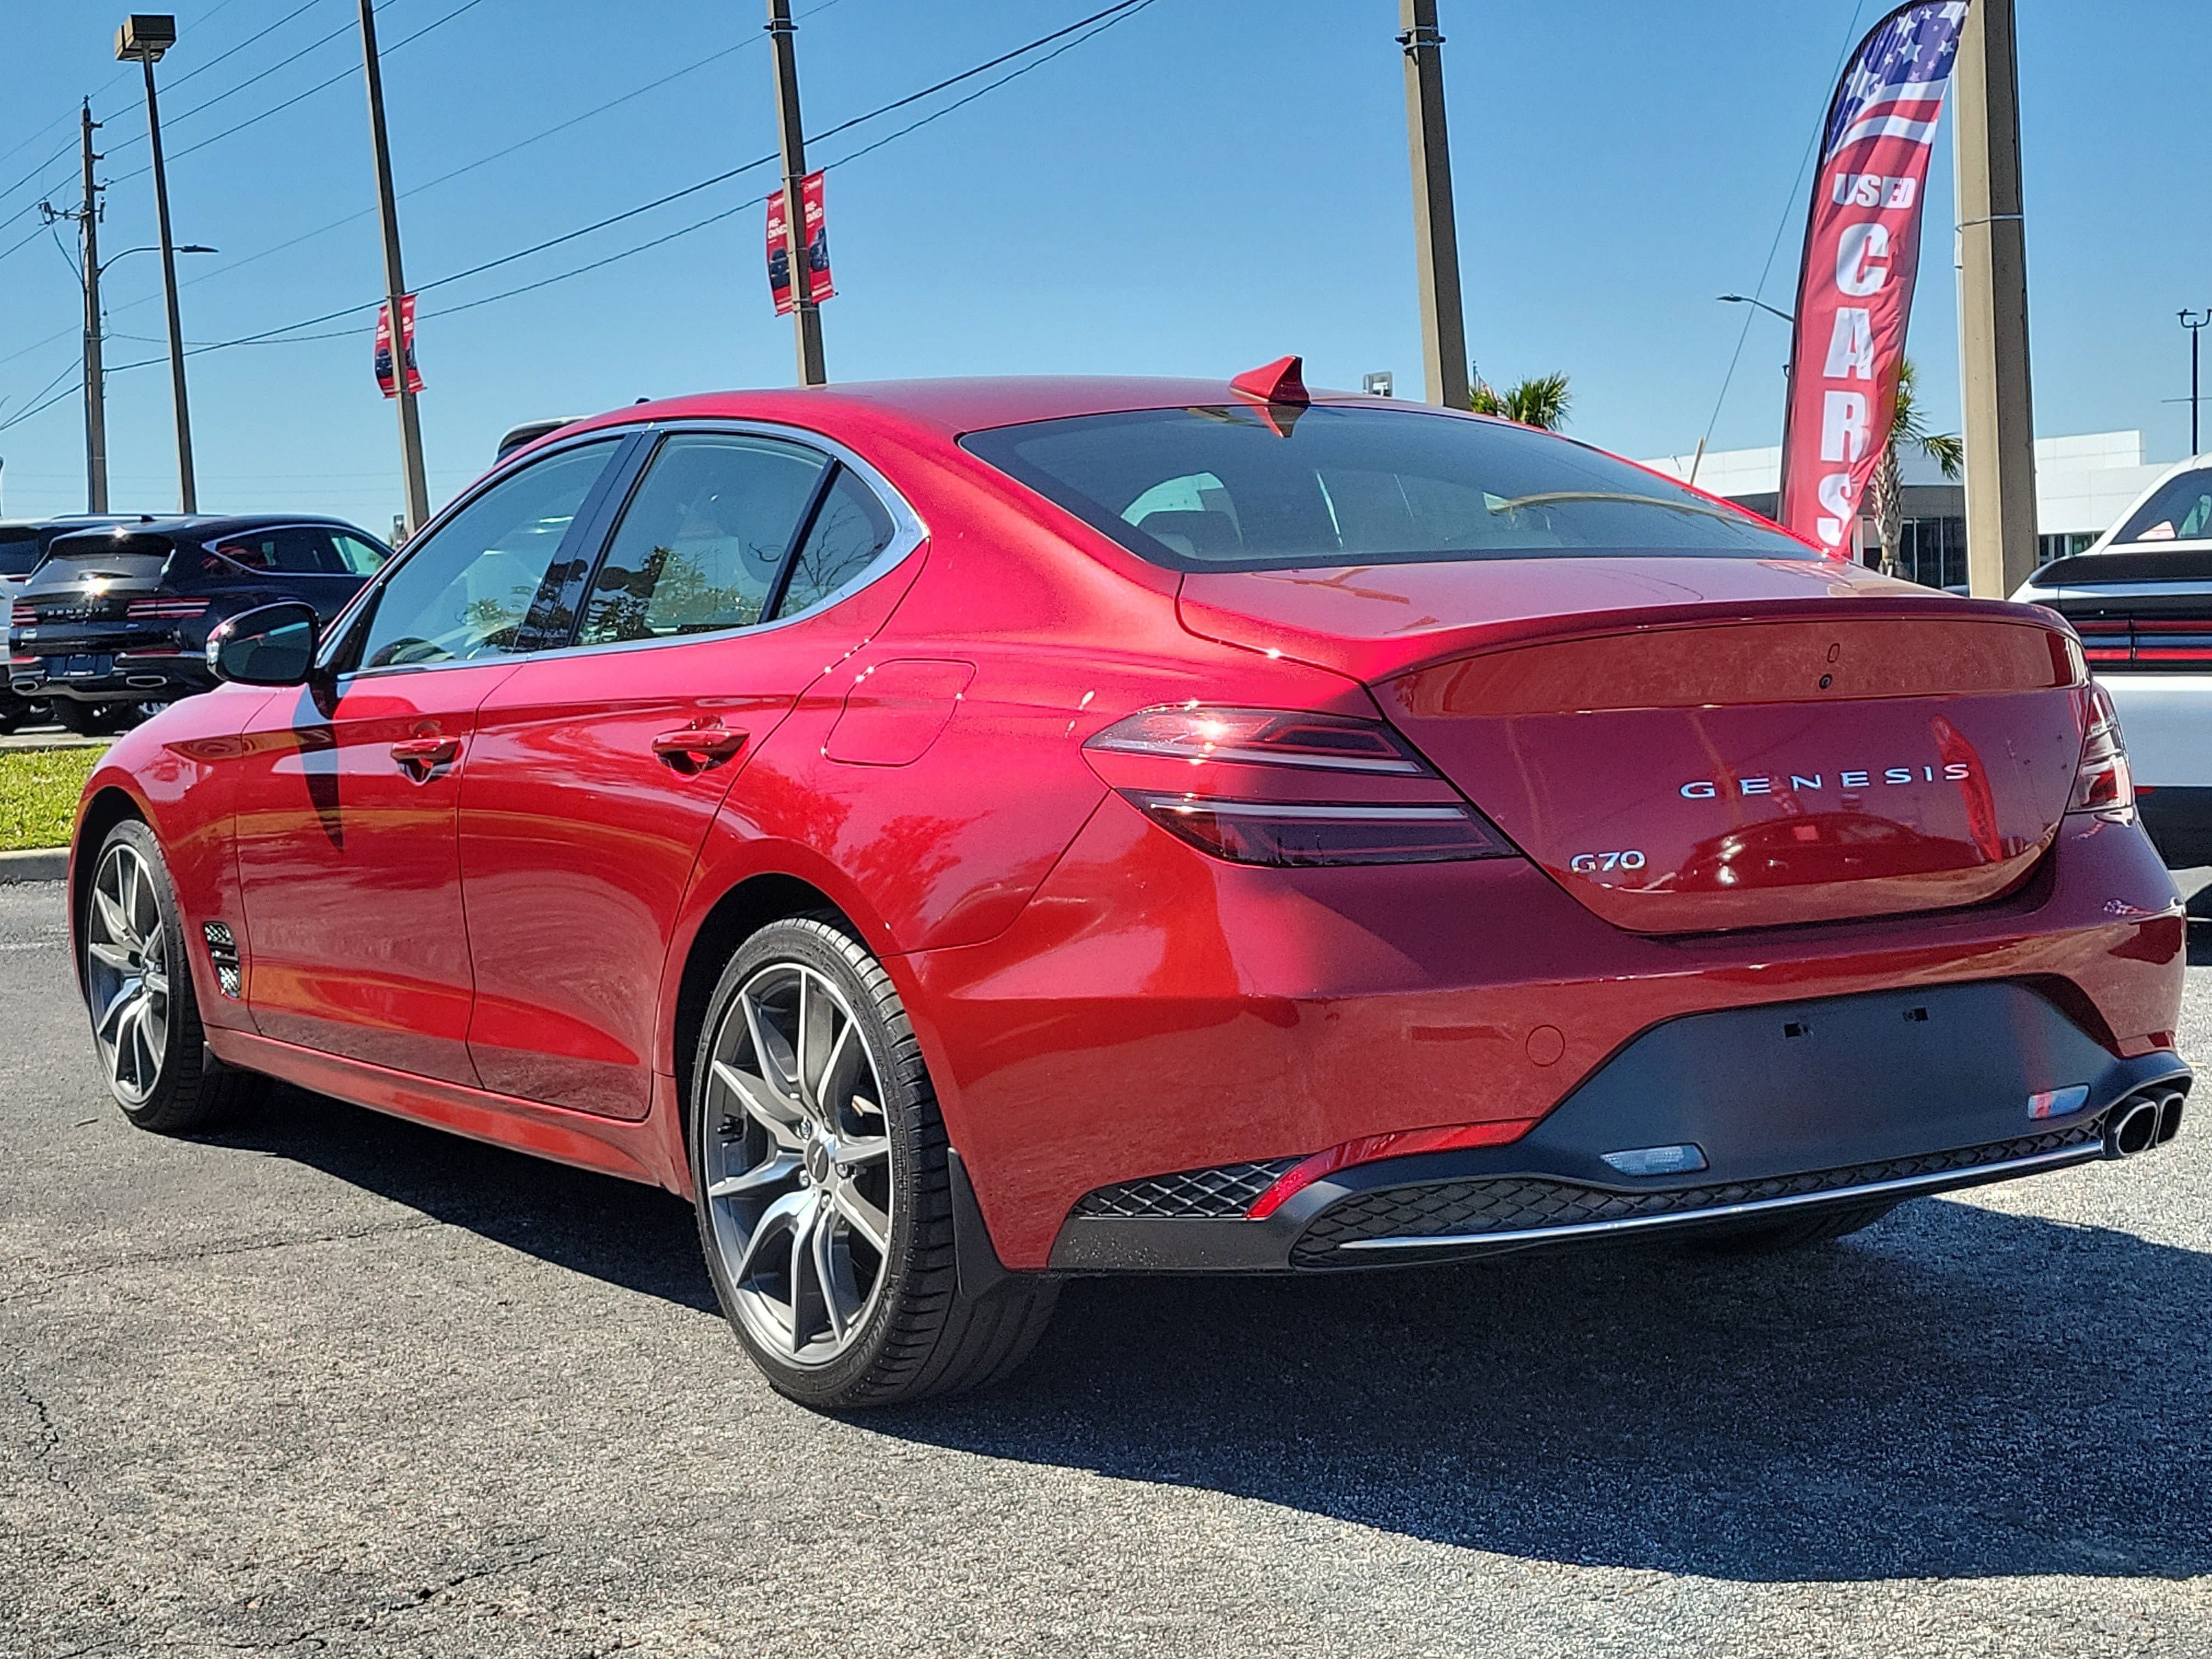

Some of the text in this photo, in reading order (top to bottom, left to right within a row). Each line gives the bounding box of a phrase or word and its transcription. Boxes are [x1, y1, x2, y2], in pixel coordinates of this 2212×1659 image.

[1832, 172, 1916, 209] USED
[1816, 223, 1889, 546] CARS
[1679, 763, 1971, 799] GENESIS
[1571, 850, 1646, 873] G70
